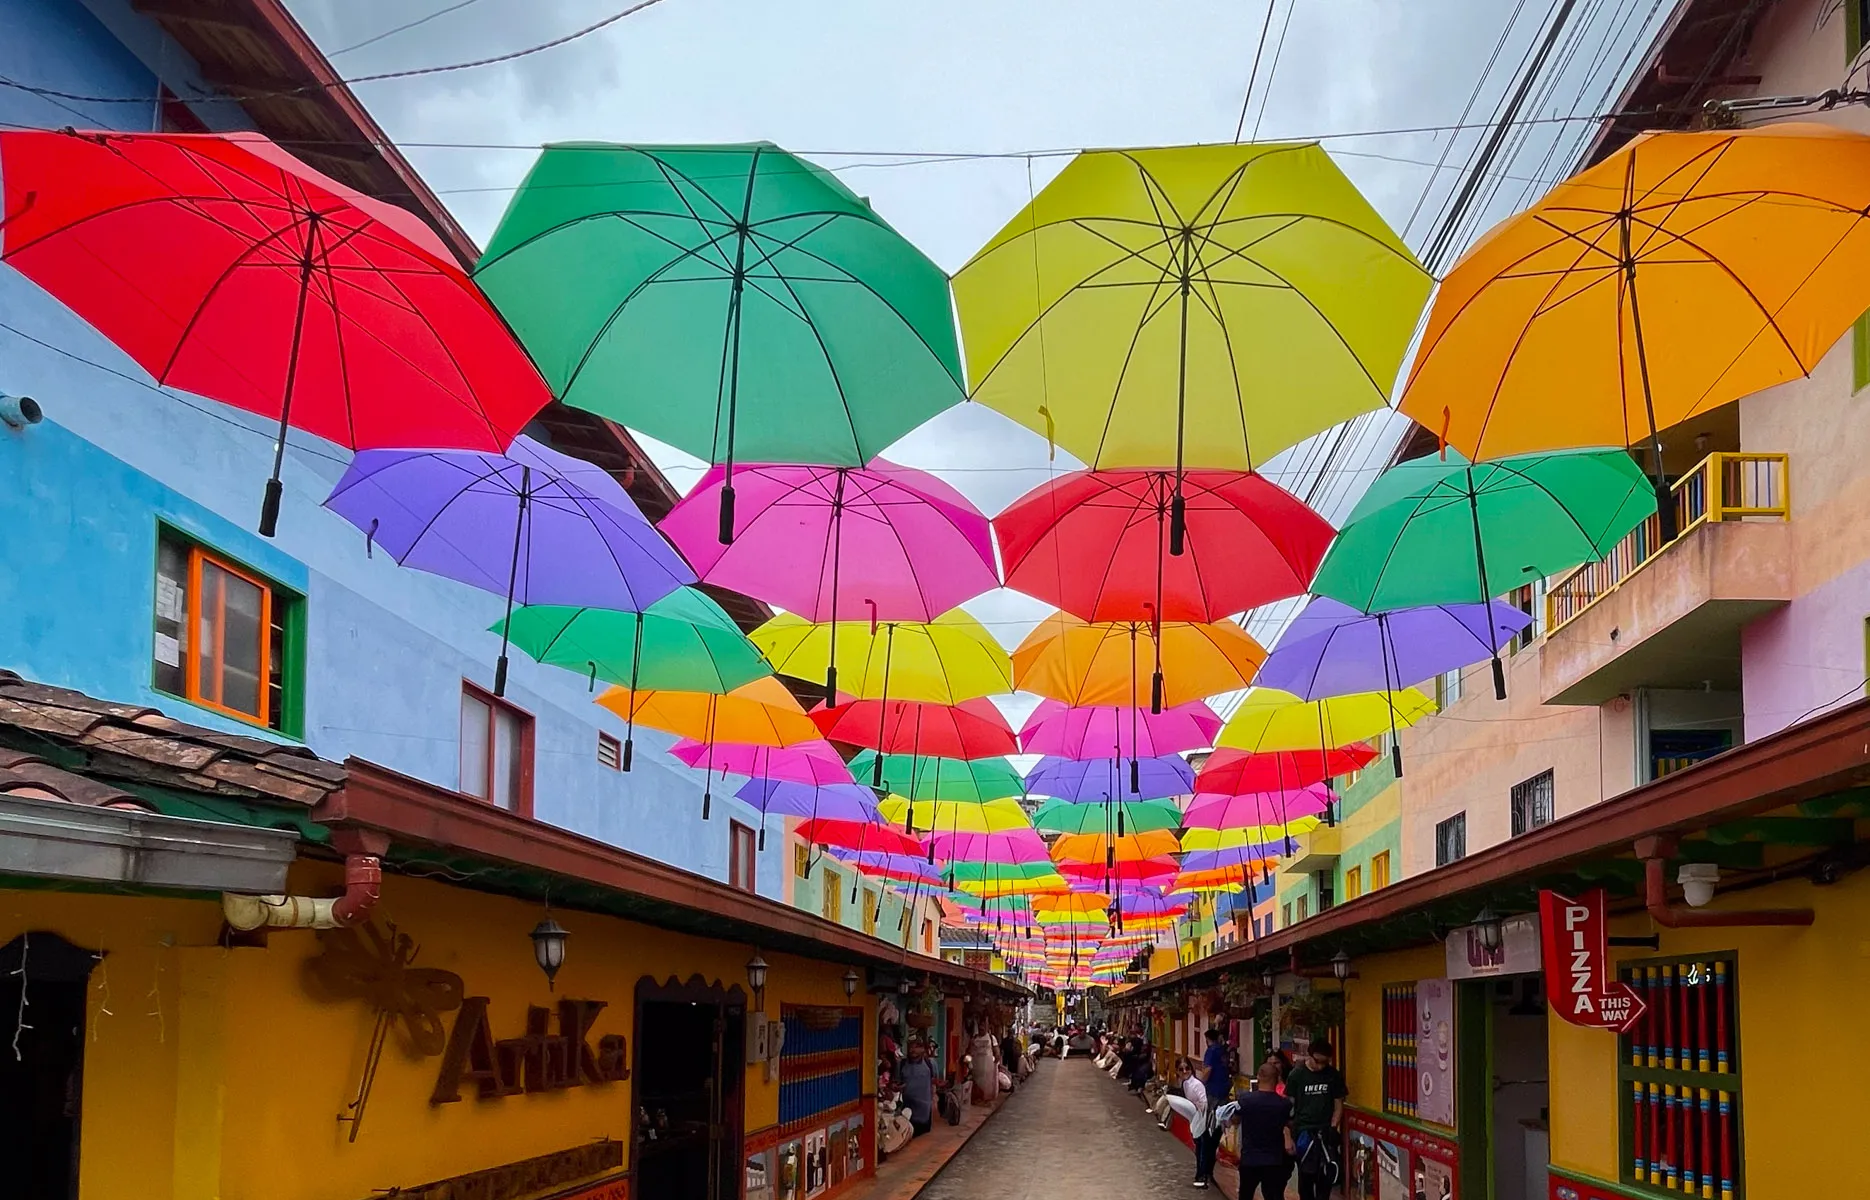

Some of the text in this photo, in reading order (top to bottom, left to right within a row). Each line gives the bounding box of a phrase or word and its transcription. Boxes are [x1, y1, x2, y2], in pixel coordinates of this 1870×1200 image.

[1566, 906, 1594, 1014] PIZZA
[1598, 997, 1631, 1009] THIS
[1601, 1009, 1629, 1021] WAY
